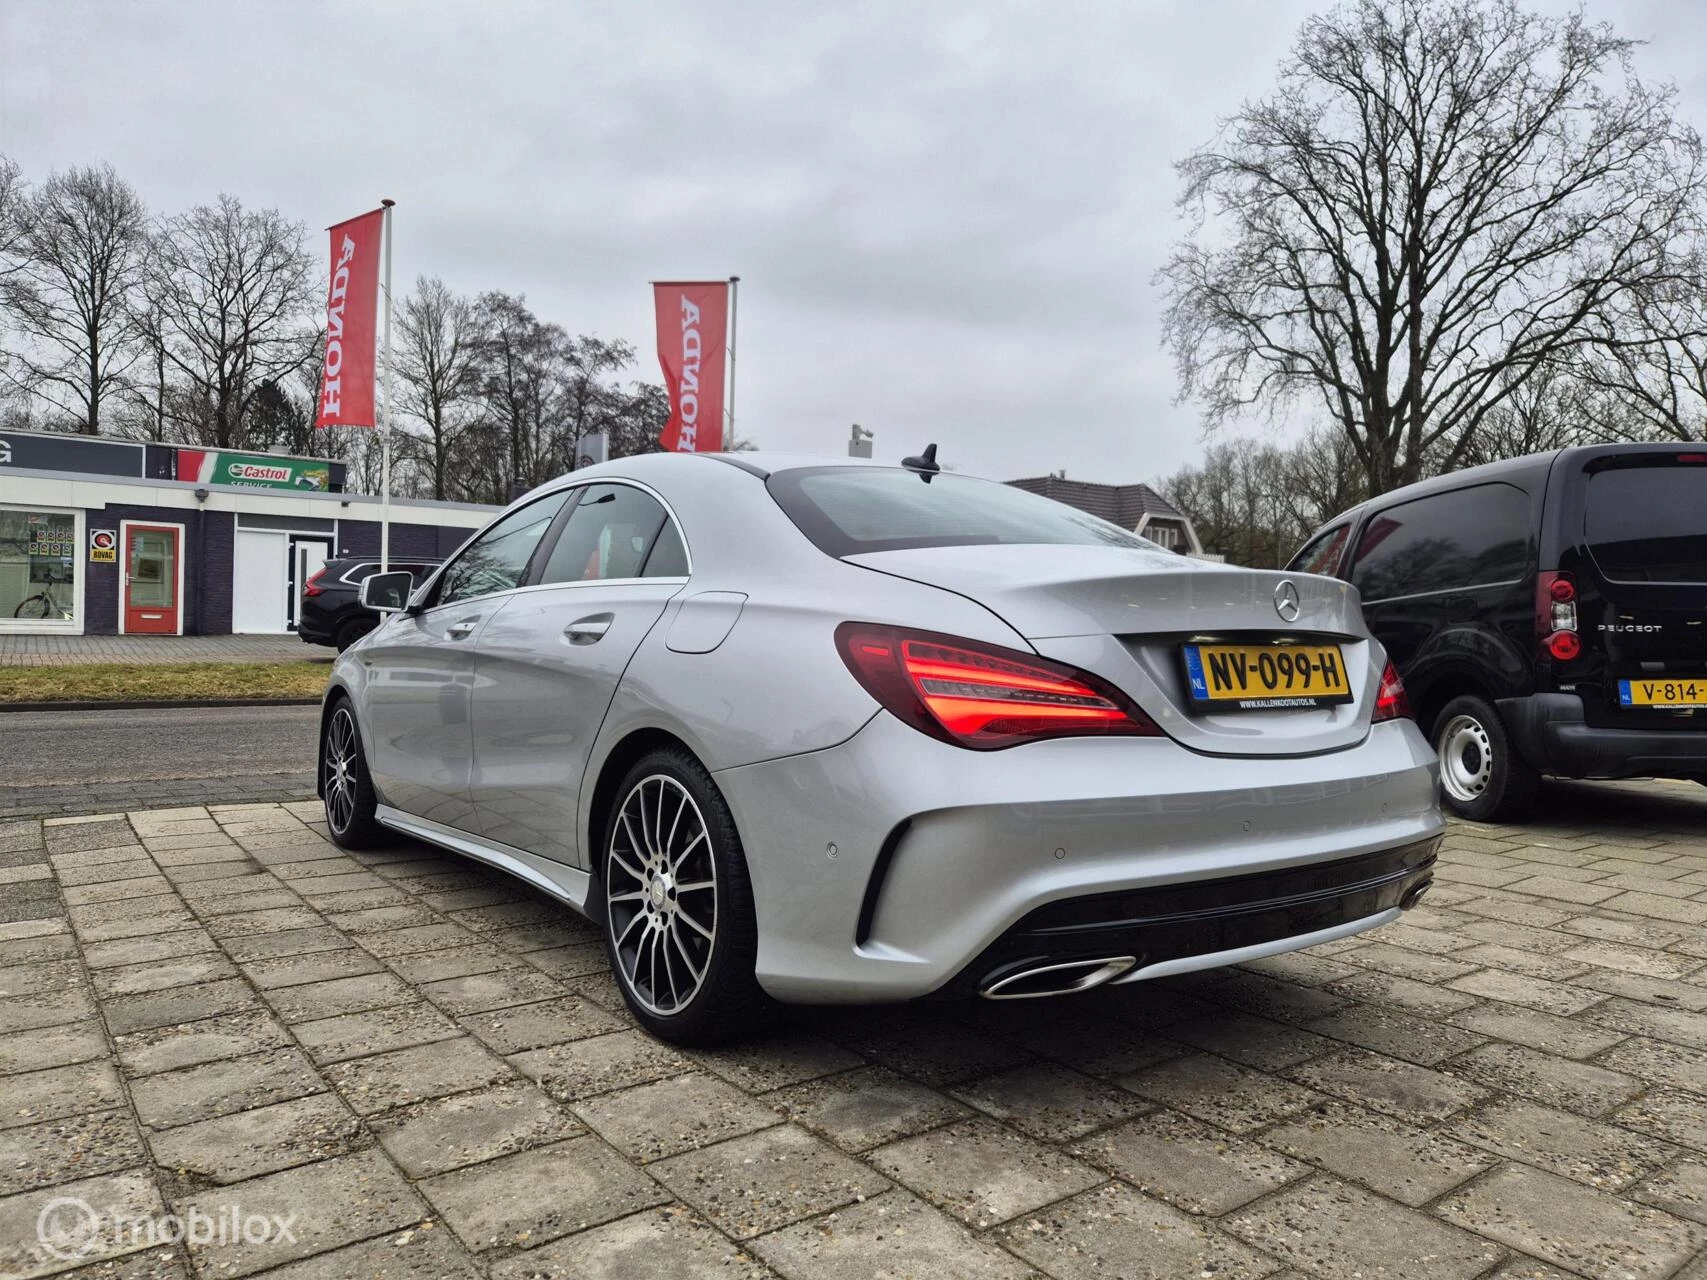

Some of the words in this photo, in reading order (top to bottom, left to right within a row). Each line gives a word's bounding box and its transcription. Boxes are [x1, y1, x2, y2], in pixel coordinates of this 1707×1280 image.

[244, 466, 288, 480] Castrol
[93, 550, 113, 559] BOVAG
[1597, 624, 1663, 633] PEUGEOT
[1207, 652, 1341, 691] NV-099-H
[1192, 678, 1206, 690] NL
